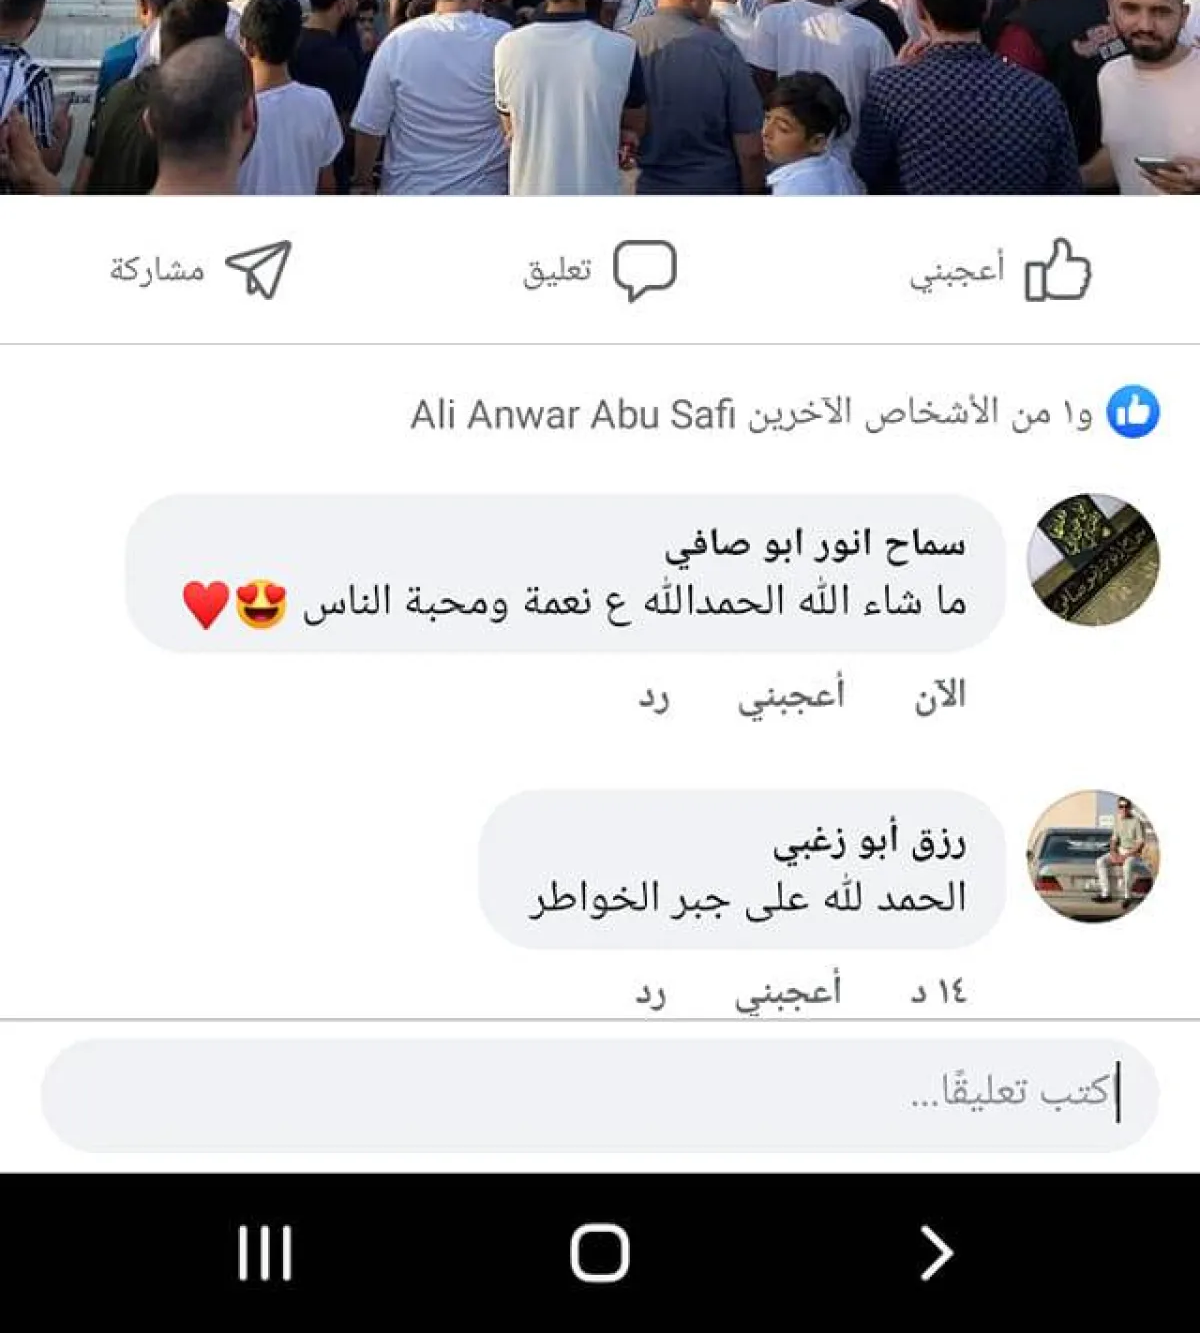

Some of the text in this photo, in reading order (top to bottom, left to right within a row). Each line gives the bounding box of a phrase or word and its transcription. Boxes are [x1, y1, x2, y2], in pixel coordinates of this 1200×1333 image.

[111, 257, 204, 287] مشاركة
[523, 257, 591, 291] تعليق
[911, 248, 1003, 294] أعجبني
[410, 397, 454, 429] Ali
[467, 399, 580, 429] Anwar
[591, 397, 658, 429] Abu
[671, 397, 735, 429] Safi
[750, 395, 851, 433] الآخرين
[866, 394, 998, 433] الأشخاص
[1012, 409, 1050, 433] من
[665, 527, 965, 570] سماح انور ابو صافي
[304, 583, 390, 626] الناس
[406, 587, 508, 624] ومحبة
[525, 587, 591, 615] نعمة
[606, 592, 632, 627] ع
[799, 576, 848, 615] الله
[864, 583, 921, 616] شاء
[938, 583, 966, 615] ما
[639, 688, 669, 715] رد
[739, 671, 844, 722] أعجبني
[915, 676, 965, 718] الآن
[774, 815, 966, 868] رزق أبو زغبي
[529, 872, 965, 923] الحمد لله على جبر الخواطر
[636, 985, 666, 1011] رد
[735, 967, 840, 1017] أعجبني
[911, 977, 967, 1004] ١٤ د
